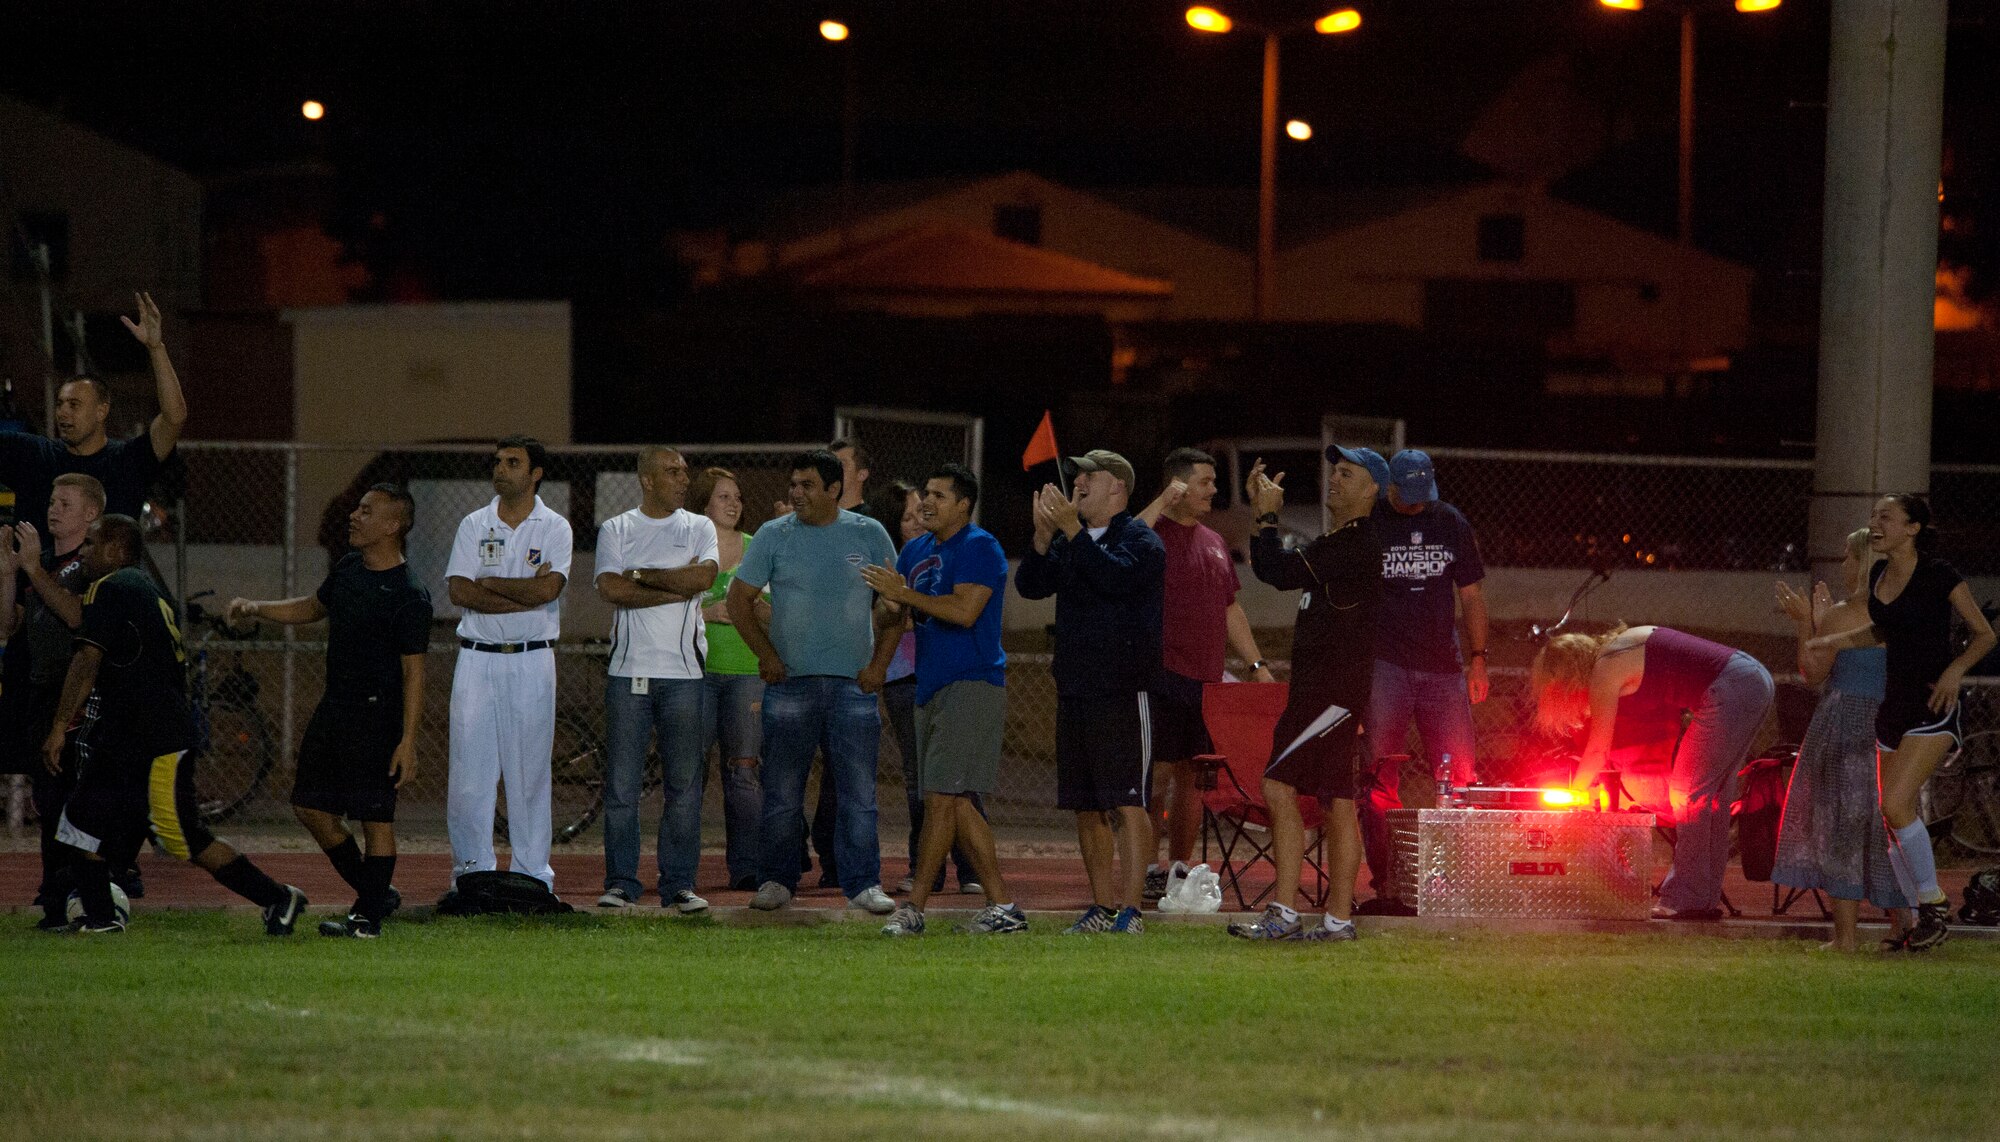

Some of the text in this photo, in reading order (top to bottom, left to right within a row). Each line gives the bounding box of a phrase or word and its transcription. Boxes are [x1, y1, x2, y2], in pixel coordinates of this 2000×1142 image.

[1382, 550, 1454, 562] DIVISION
[1381, 560, 1448, 575] HAMPIO
[1508, 862, 1566, 876] DELTA
